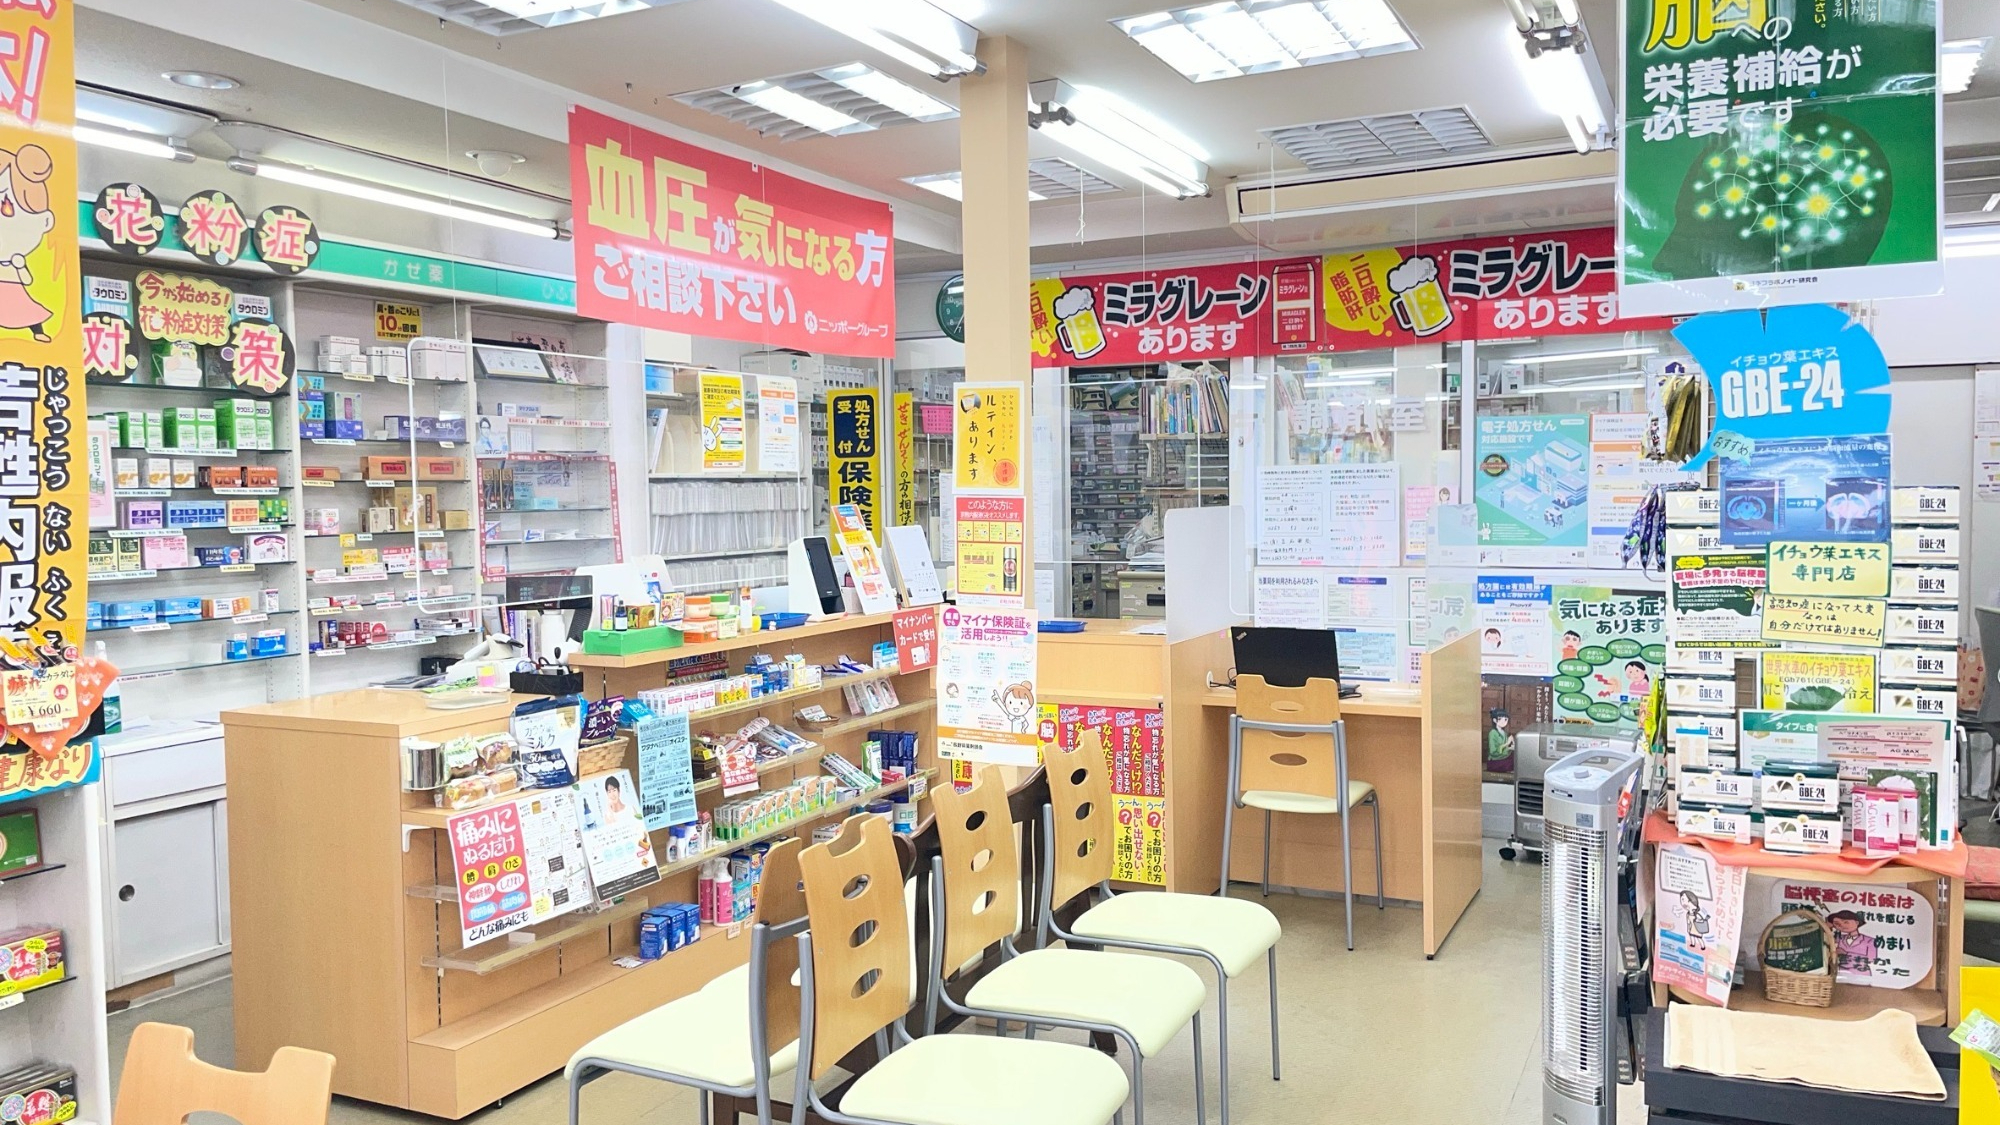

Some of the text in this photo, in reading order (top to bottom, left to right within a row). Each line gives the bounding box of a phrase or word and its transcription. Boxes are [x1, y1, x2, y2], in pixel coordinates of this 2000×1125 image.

[1815, 0, 1826, 28] さい。
[1642, 45, 1862, 103] 栄養補給が
[1641, 97, 1802, 142] 必要です
[585, 138, 888, 287] 血圧が気になる方
[383, 259, 444, 284] かぜ薬
[93, 288, 127, 300] タウロミン
[139, 273, 230, 308] 今から始める!
[593, 242, 797, 326] ご相談下さい
[1350, 254, 1388, 322] 二日酔い
[1104, 275, 1267, 326] ミラグレーン
[1330, 270, 1364, 321] 脂肪肝
[237, 304, 268, 315] タウロミン
[1494, 293, 1618, 330] あります
[139, 306, 227, 339] 花粉症対策
[818, 317, 888, 337] ニッポーグループ
[84, 321, 125, 371] 対
[1138, 322, 1244, 355] あります
[239, 329, 281, 382] 策
[1730, 346, 1839, 368] イチョウ葉エキス
[1720, 360, 1845, 419] GBE-24
[837, 401, 853, 454] 受付
[854, 399, 871, 453] 処方せん
[1481, 419, 1557, 434] 電子処方せん
[969, 421, 980, 480] あります
[1712, 436, 1750, 456] おすすめ
[967, 500, 1013, 511] このような方に
[1920, 499, 1946, 508] GBE-24
[43, 502, 70, 553] ない
[1772, 544, 1882, 562] イチョウ葉エキス
[1919, 538, 1945, 548] GBE-24
[1791, 563, 1857, 583] 専門店
[43, 568, 70, 620] ふく
[1918, 579, 1944, 589] GBE-24
[896, 612, 932, 629] マイナンバー
[961, 614, 1031, 629] マイナ保険証を
[1802, 611, 1837, 622] なのは
[1918, 619, 1944, 629] GBE-24
[899, 627, 936, 646] カードで受付
[1769, 620, 1882, 642] 自分だけではありません!
[1766, 659, 1872, 678] 世界水準のイチョウ葉エキス
[1917, 659, 1943, 670] GBE-24
[1699, 688, 1723, 698] GBE-24
[1844, 687, 1873, 701] 冷え
[28, 702, 61, 717] ¥660
[1917, 699, 1943, 710] GBE-24
[1040, 722, 1054, 738] 脳
[526, 734, 556, 749] ミルク
[1131, 726, 1143, 794] なんだっけ!?
[1716, 782, 1738, 792] GBE-24
[1799, 787, 1826, 798] GBE-24
[456, 808, 517, 848] 痛みに
[1713, 820, 1735, 830] GBE-24
[1803, 829, 1828, 840] GBE-24
[463, 835, 516, 866] ぬるだけ
[488, 864, 497, 877] 肩
[504, 856, 519, 871] ひざ
[500, 875, 522, 890] しびれ
[1784, 885, 1915, 909] 脳梗塞の兆候は
[468, 911, 529, 942] どんな痛みにも
[1874, 935, 1911, 951] めまい
